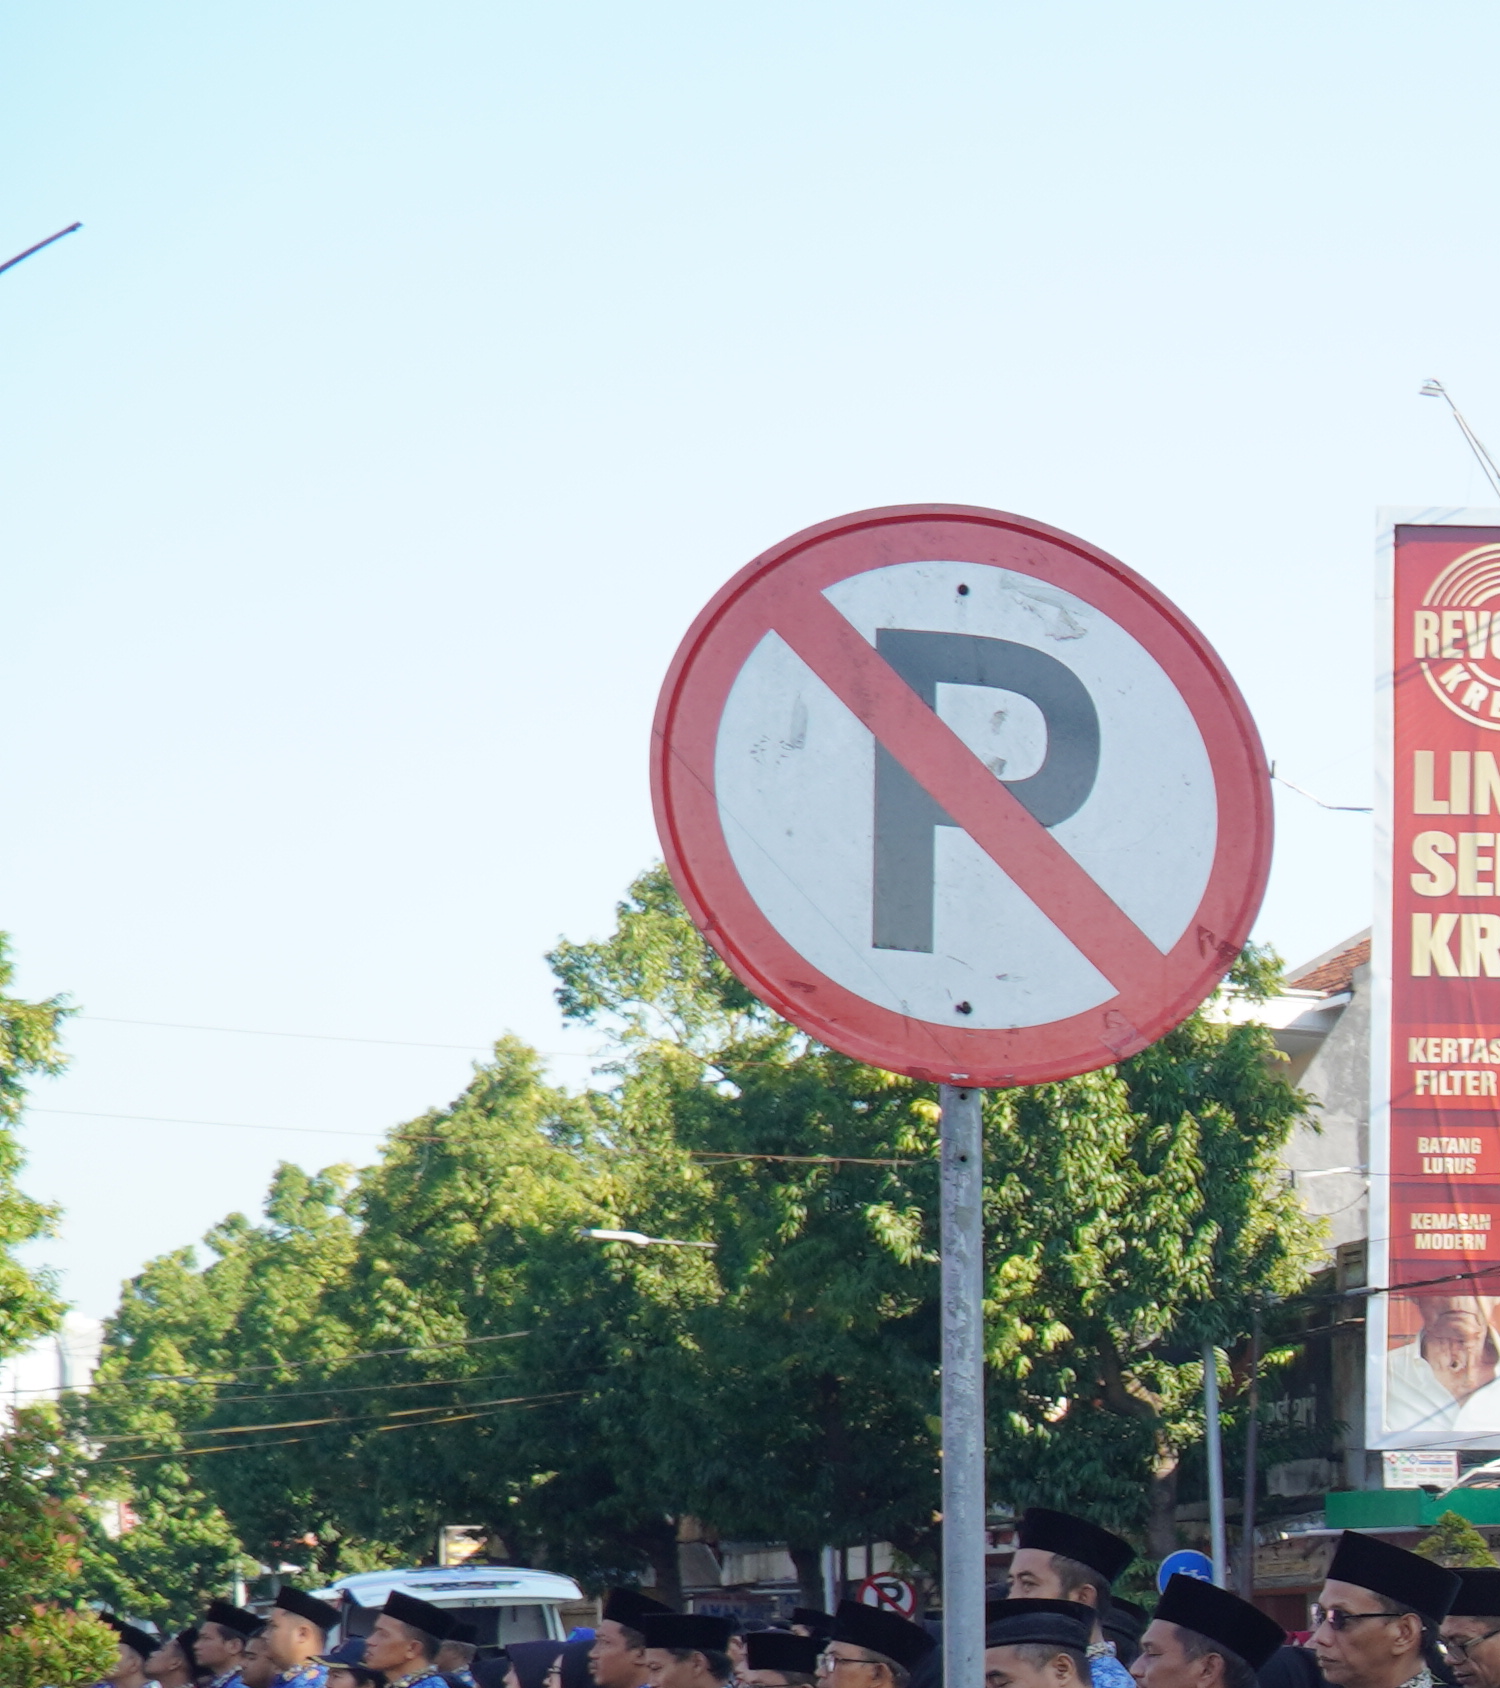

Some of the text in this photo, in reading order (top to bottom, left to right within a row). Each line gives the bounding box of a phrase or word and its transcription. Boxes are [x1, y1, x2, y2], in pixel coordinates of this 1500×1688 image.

[872, 627, 1100, 954] P
[1415, 1069, 1498, 1097] FILTER
[1417, 1136, 1482, 1154] BATANG
[1423, 1156, 1477, 1175] LURUS
[1410, 1212, 1491, 1231] KEMASAN
[1415, 1233, 1487, 1251] MODERN
